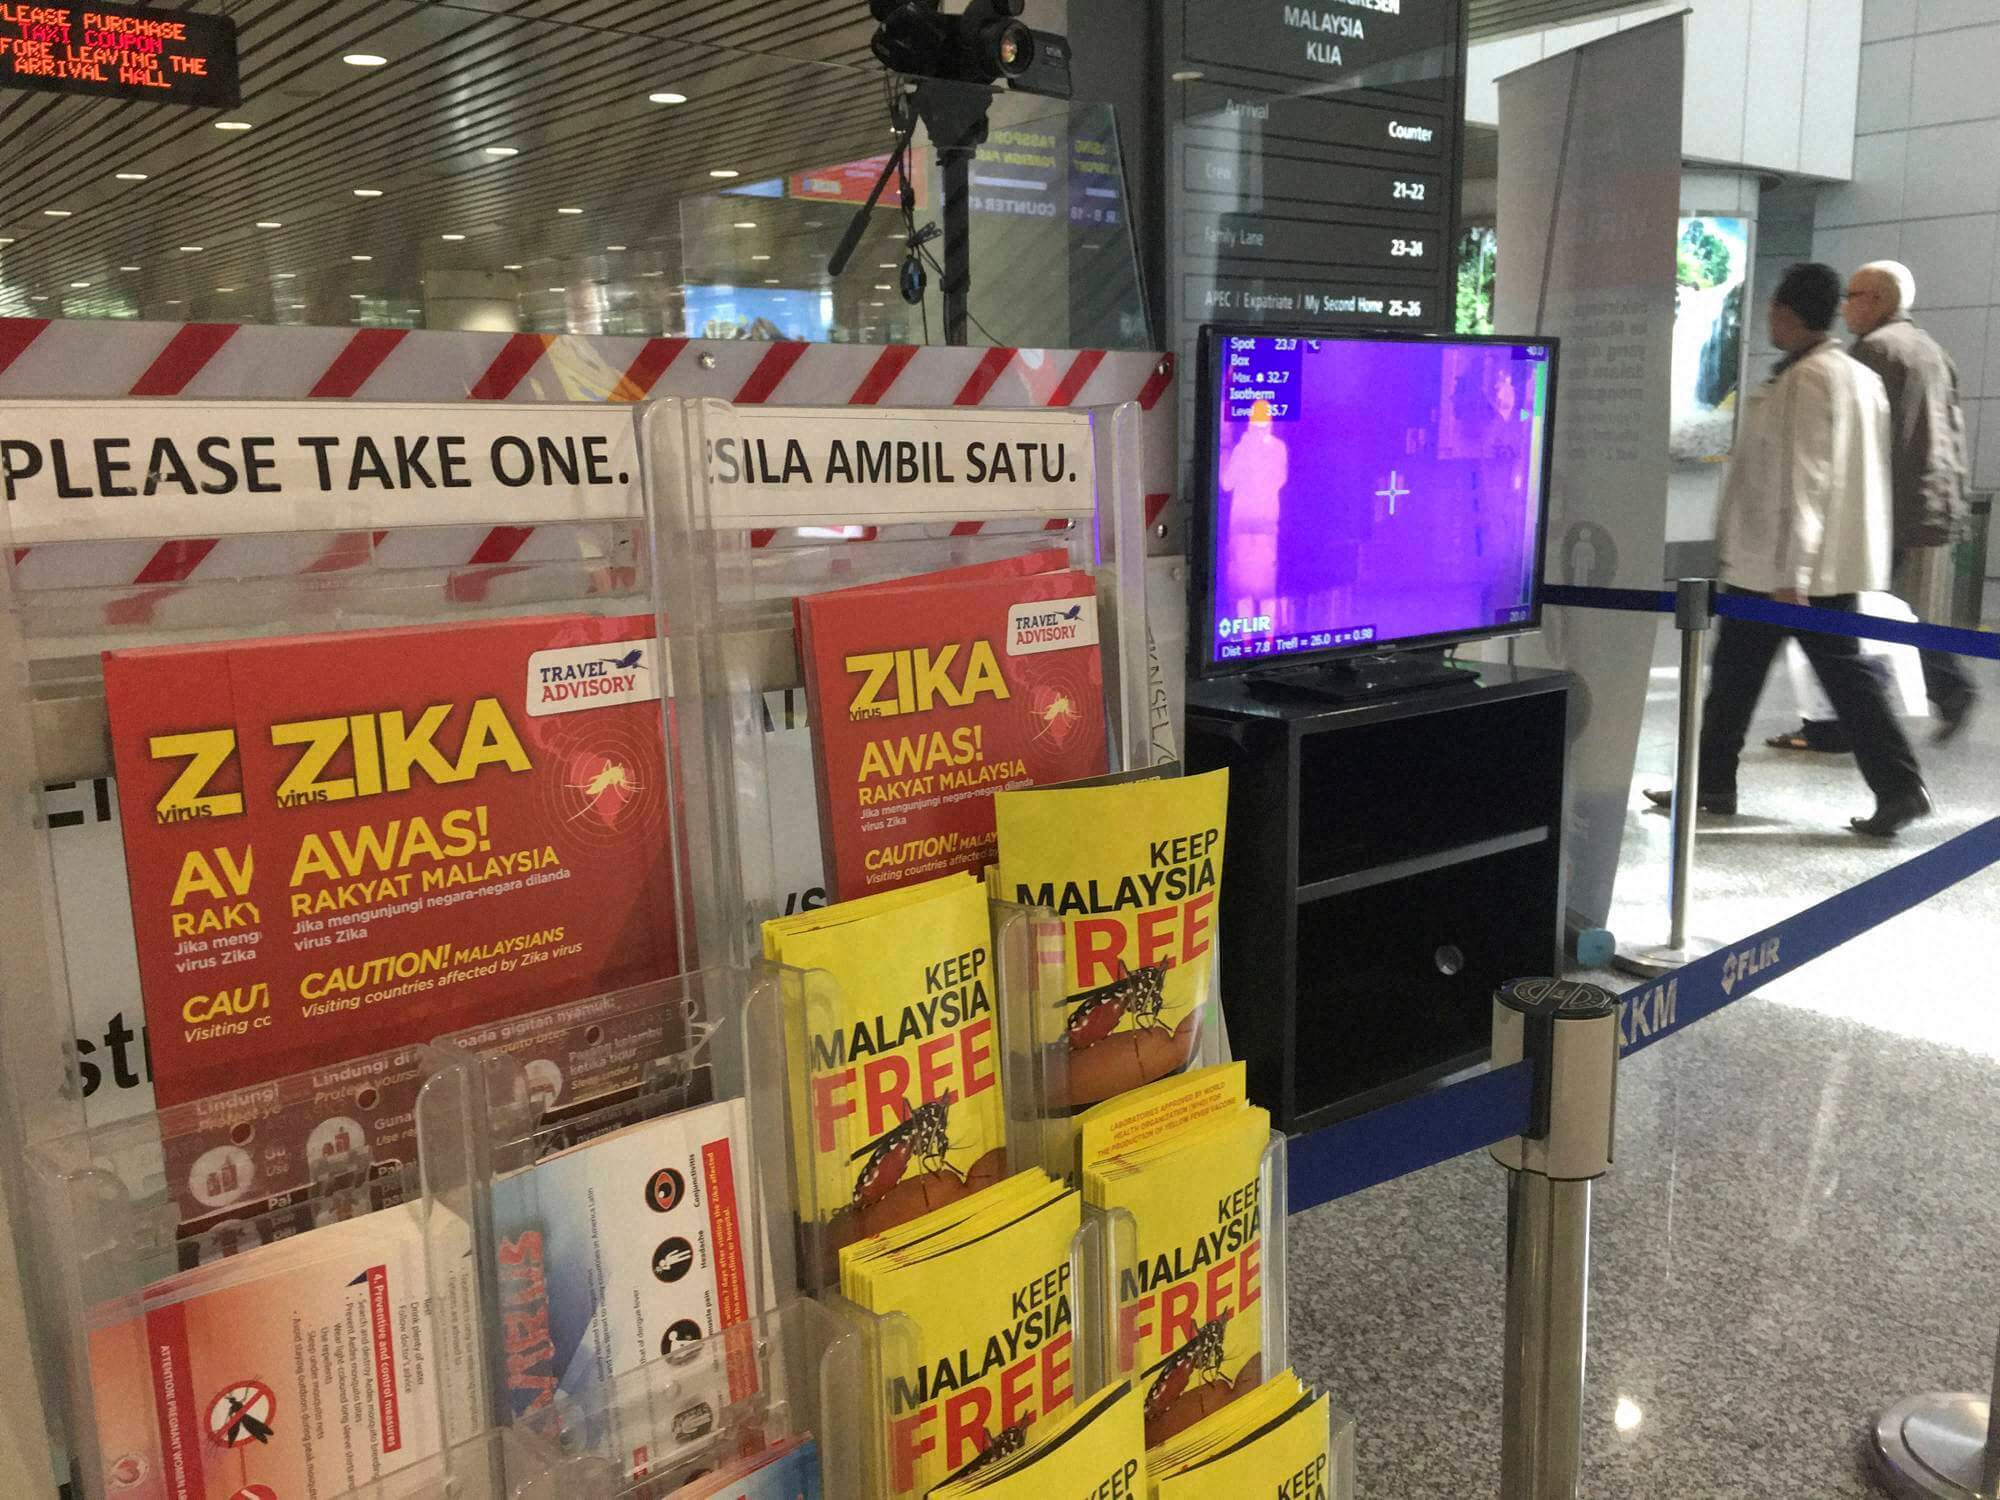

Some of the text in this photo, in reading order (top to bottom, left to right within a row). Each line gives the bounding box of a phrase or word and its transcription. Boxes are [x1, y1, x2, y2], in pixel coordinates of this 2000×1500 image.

[18, 20, 163, 54] TAXI COUPON
[83, 13, 187, 41] PURCHASE
[1284, 5, 1364, 40] MALAYSIA
[14, 55, 172, 88] ARRIVAL HALL
[67, 44, 158, 70] LEAVING
[168, 55, 208, 75] THE
[1306, 41, 1342, 66] KLIA
[1225, 98, 1433, 142] Arrival Counter
[1393, 181, 1425, 200] 21-22
[1390, 239, 1423, 257] 23-24
[1204, 290, 1421, 317] APEC Expatriate My Second Home 25-26
[1230, 337, 1256, 352] Spot
[1231, 354, 1249, 366] Box
[1229, 387, 1275, 400] Isotherm
[1266, 371, 1290, 383] 32.7
[0, 434, 631, 501] PLEASE TAKE ONE.
[714, 437, 1077, 485] SILA AMBIL SATU.
[1016, 613, 1059, 630] TRAVEL
[1016, 625, 1076, 645] ADVISORY
[1232, 616, 1271, 634] FLIR
[540, 661, 608, 683] TRAVEL
[1222, 645, 1242, 658] Dist
[541, 674, 637, 702] ADVISORY
[846, 640, 1010, 721] ZIKA
[850, 707, 882, 721] virus
[270, 698, 533, 808] ZIKA
[858, 725, 984, 782] AWAS!
[276, 789, 329, 808] virus
[859, 759, 1027, 806] RAKYAT MALAYSIA
[157, 803, 213, 823] virus
[861, 807, 880, 819] Jika
[882, 797, 941, 816] mengunjungi
[861, 816, 907, 832] virus Zika
[289, 805, 491, 887] AWAS!
[864, 833, 958, 871] CAUTION!
[1150, 828, 1218, 868] KEEP
[290, 846, 560, 918] RAKYAT MALAYSIA
[866, 858, 947, 885] Visiting countries
[1016, 857, 1216, 916] MALAYSIA
[292, 868, 571, 936] Jika mengunjungi negara-negara dilanda
[174, 940, 208, 956] Jika
[176, 949, 257, 973] virus Zika
[294, 926, 368, 952] virus Zika
[1028, 890, 1215, 989] FREE
[1737, 937, 1781, 981] FLIR
[300, 927, 565, 1001] CAUTION! MALAYSIANS
[301, 941, 583, 1019] Visiting countries affected by Zika virus
[924, 948, 986, 994] KEEP
[184, 1019, 248, 1043] Visiting
[813, 980, 991, 1073] MALAYSIA
[312, 1058, 389, 1088] Lindungi
[813, 1017, 996, 1154] FREE
[689, 1154, 700, 1207] Conjunctivitis
[587, 1187, 599, 1238] America Latin
[697, 1230, 707, 1269] Headache
[707, 1152, 731, 1320] within days the Zika affected
[1121, 1205, 1261, 1302] MALAYSIA
[704, 1290, 714, 1335] muscle pain
[1012, 1262, 1071, 1320] KEEP
[1119, 1239, 1262, 1373] FREE
[399, 1305, 407, 1332] Follow
[320, 1327, 333, 1384] Use repellents
[345, 1303, 363, 1423] Prevent Aedes mosquito bites
[358, 1299, 377, 1442] Search and destroy Aedes mosquito
[373, 1274, 396, 1446] 4. Preventive and control measures
[411, 1326, 425, 1384] plenty water
[892, 1294, 1072, 1415] MALAYSIA
[292, 1318, 313, 1463] Avoid staying outdoors during peak
[307, 1330, 325, 1439] Sleep under mosquito nets
[333, 1323, 355, 1473] Wear long sleeve shirts
[160, 1345, 186, 1488] ATTENTION! PREGNANT WOMEN
[891, 1330, 1074, 1495] FREE
[1277, 1452, 1327, 1500] KEEP
